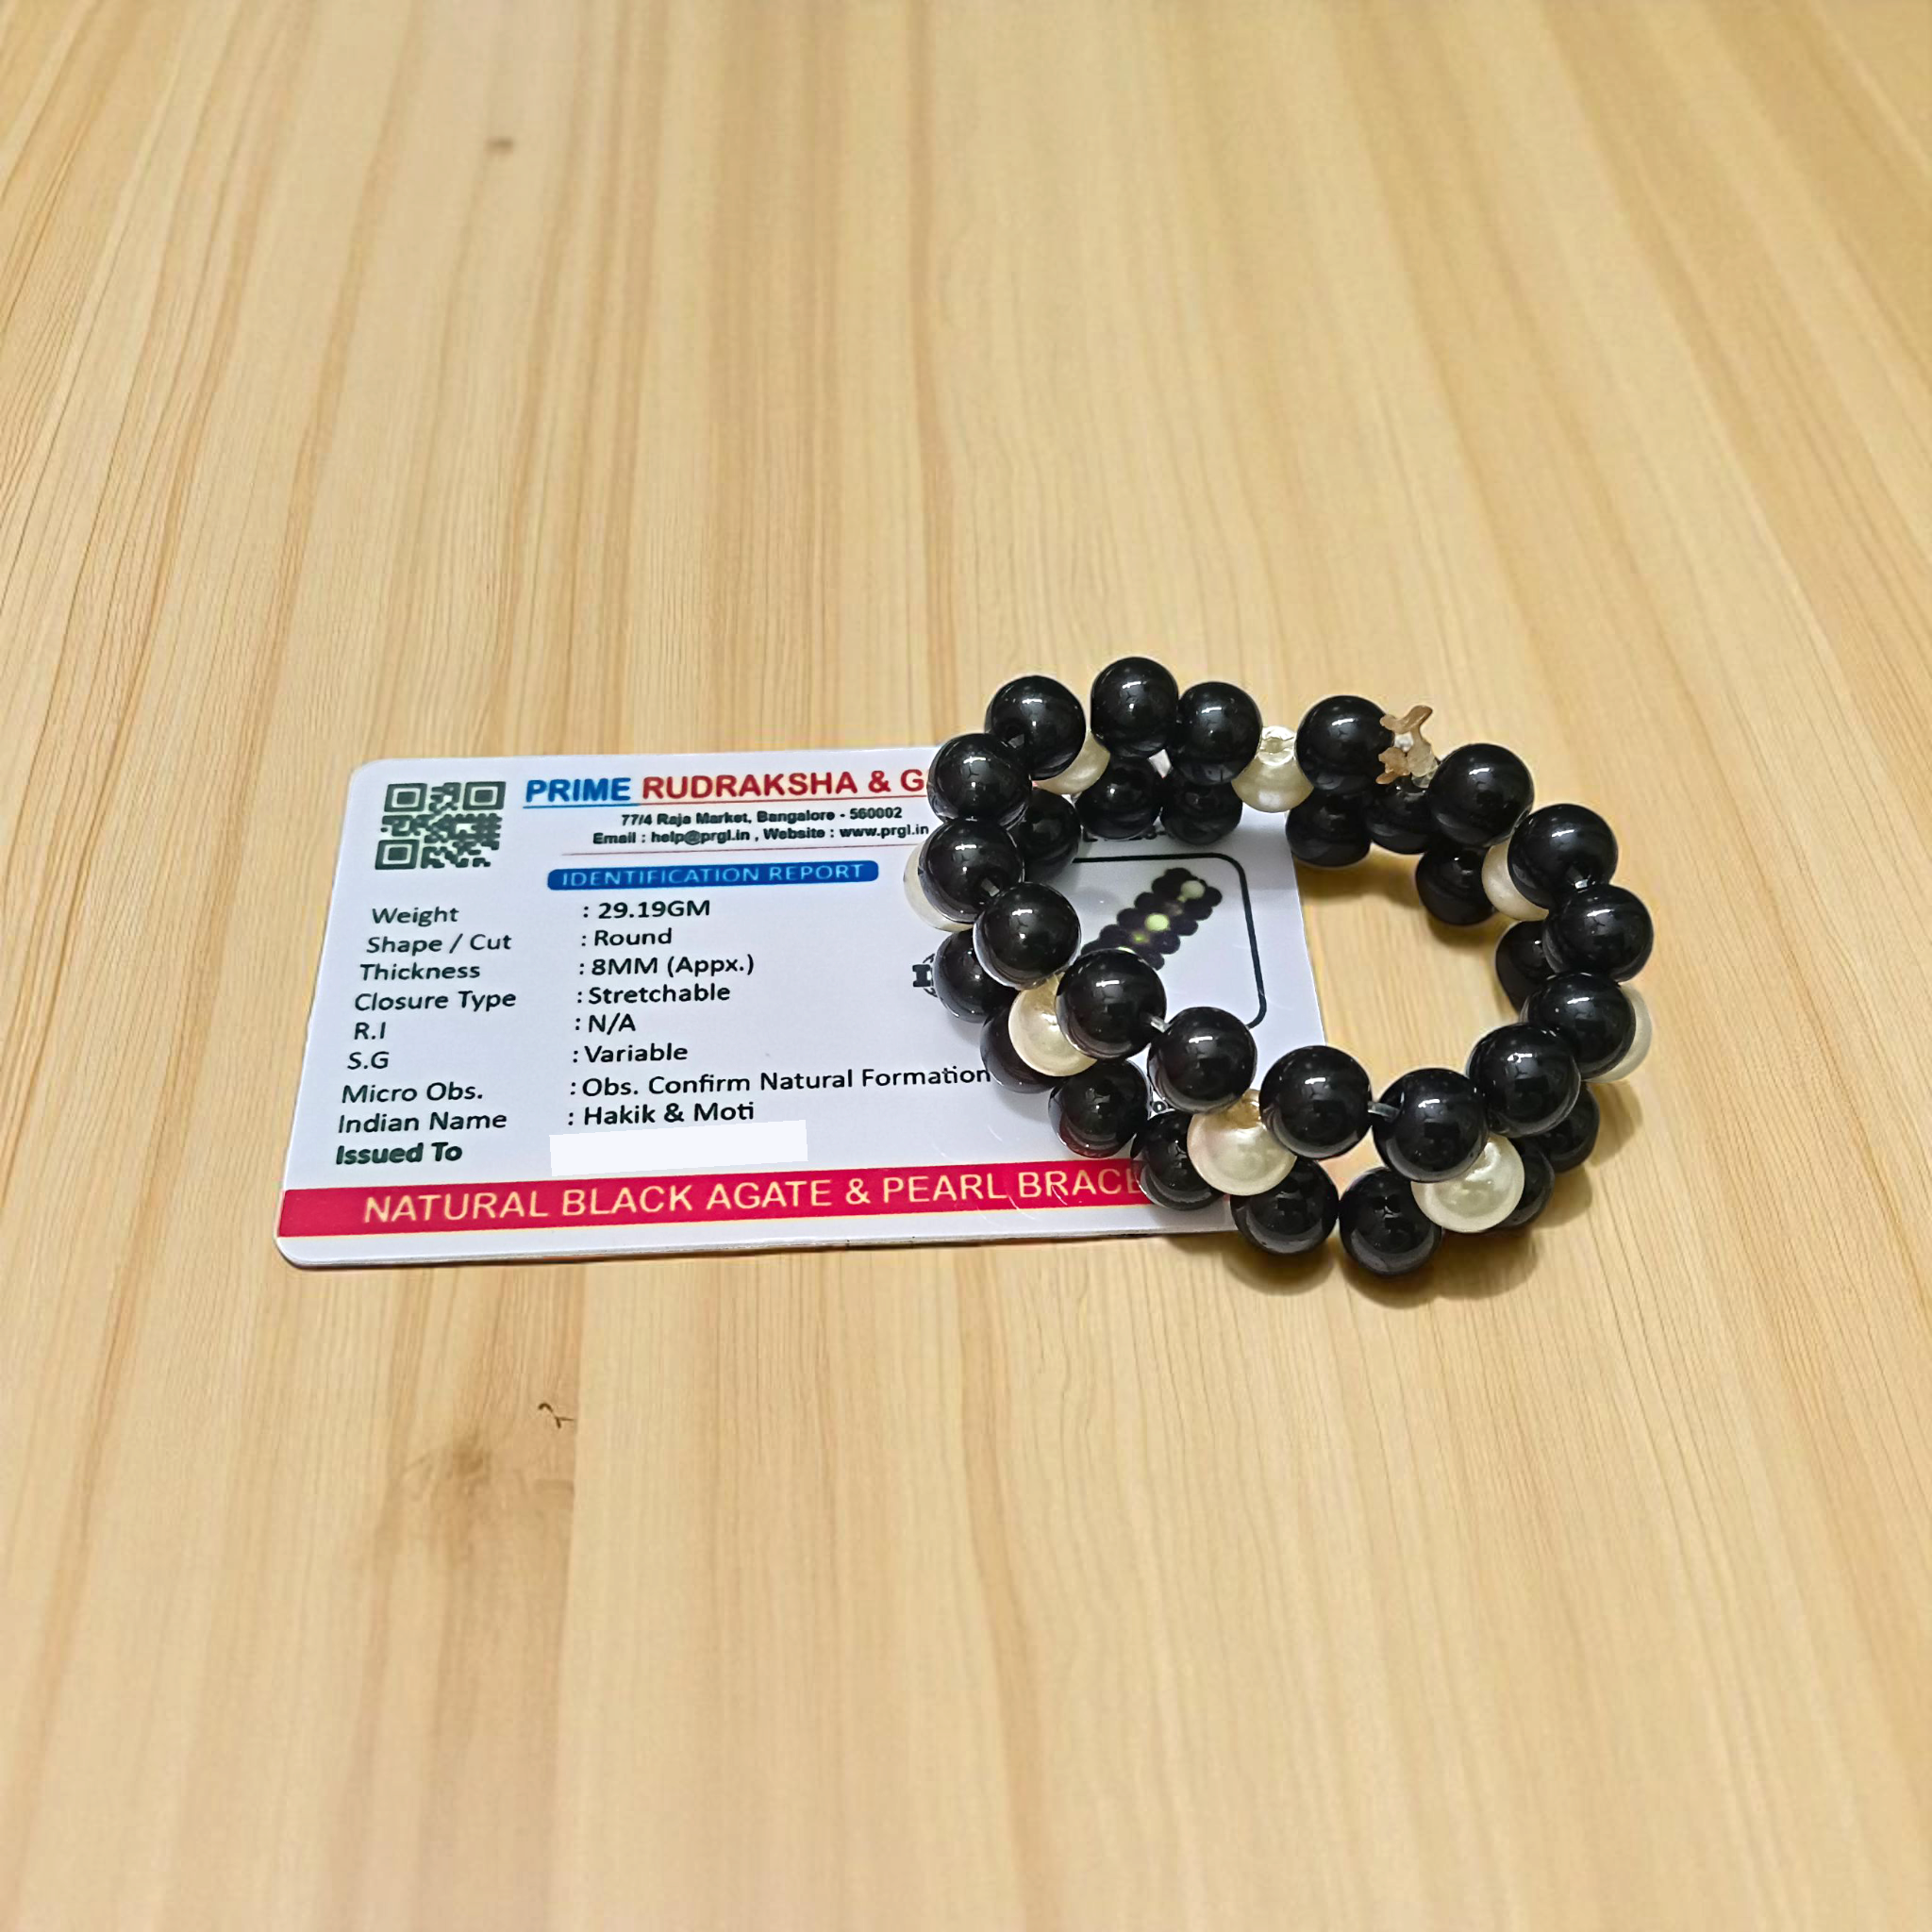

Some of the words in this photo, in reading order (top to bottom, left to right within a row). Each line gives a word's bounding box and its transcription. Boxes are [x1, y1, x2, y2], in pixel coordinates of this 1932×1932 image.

[526, 777, 631, 802] PRIME
[643, 772, 857, 798] RUDRAKSHA
[869, 771, 891, 792] &
[622, 814, 652, 825] 77/4
[658, 813, 691, 827] Raja
[696, 812, 752, 824] Market,
[758, 810, 835, 824] Bangalore
[850, 807, 902, 820] 560002
[593, 832, 636, 844] Email
[651, 829, 750, 845] help@prgl.in
[763, 827, 825, 840] Website
[840, 824, 929, 839] www.prgl.in
[563, 868, 760, 888] IDENTIFICATION
[770, 864, 862, 884] REPORT
[373, 907, 458, 926] Weight
[599, 900, 709, 919] 29.19GM
[367, 937, 442, 956] Shape
[449, 934, 463, 954] /
[470, 934, 511, 950] Cut
[595, 927, 672, 945] Round
[360, 962, 479, 980] Thickness
[592, 958, 658, 975] 8MM
[668, 954, 754, 977] (Appx.)
[356, 992, 448, 1010] Closure
[458, 991, 516, 1011] Type
[589, 983, 730, 1004] Stretchable
[355, 1022, 386, 1040] R.I
[589, 1013, 636, 1035] N/A
[347, 1051, 389, 1070] S.G
[585, 1043, 688, 1062] Variable
[342, 1085, 417, 1103] Micro
[427, 1082, 482, 1100] Obs.
[583, 1077, 638, 1096] Obs.
[649, 1074, 749, 1093] Confirm
[761, 1069, 852, 1091] Natural
[863, 1066, 991, 1087] Formation
[339, 1113, 419, 1133] Indian
[430, 1112, 507, 1130] Name
[585, 1105, 655, 1124] Hakik
[664, 1103, 684, 1123] &
[694, 1102, 753, 1121] Moti
[336, 1142, 424, 1164] Issued
[431, 1142, 462, 1161] To
[365, 1191, 548, 1223] NATURAL
[563, 1185, 692, 1215] BLACK
[707, 1180, 831, 1209] AGATE
[846, 1178, 870, 1204] &
[884, 1174, 1007, 1203] PEARL
